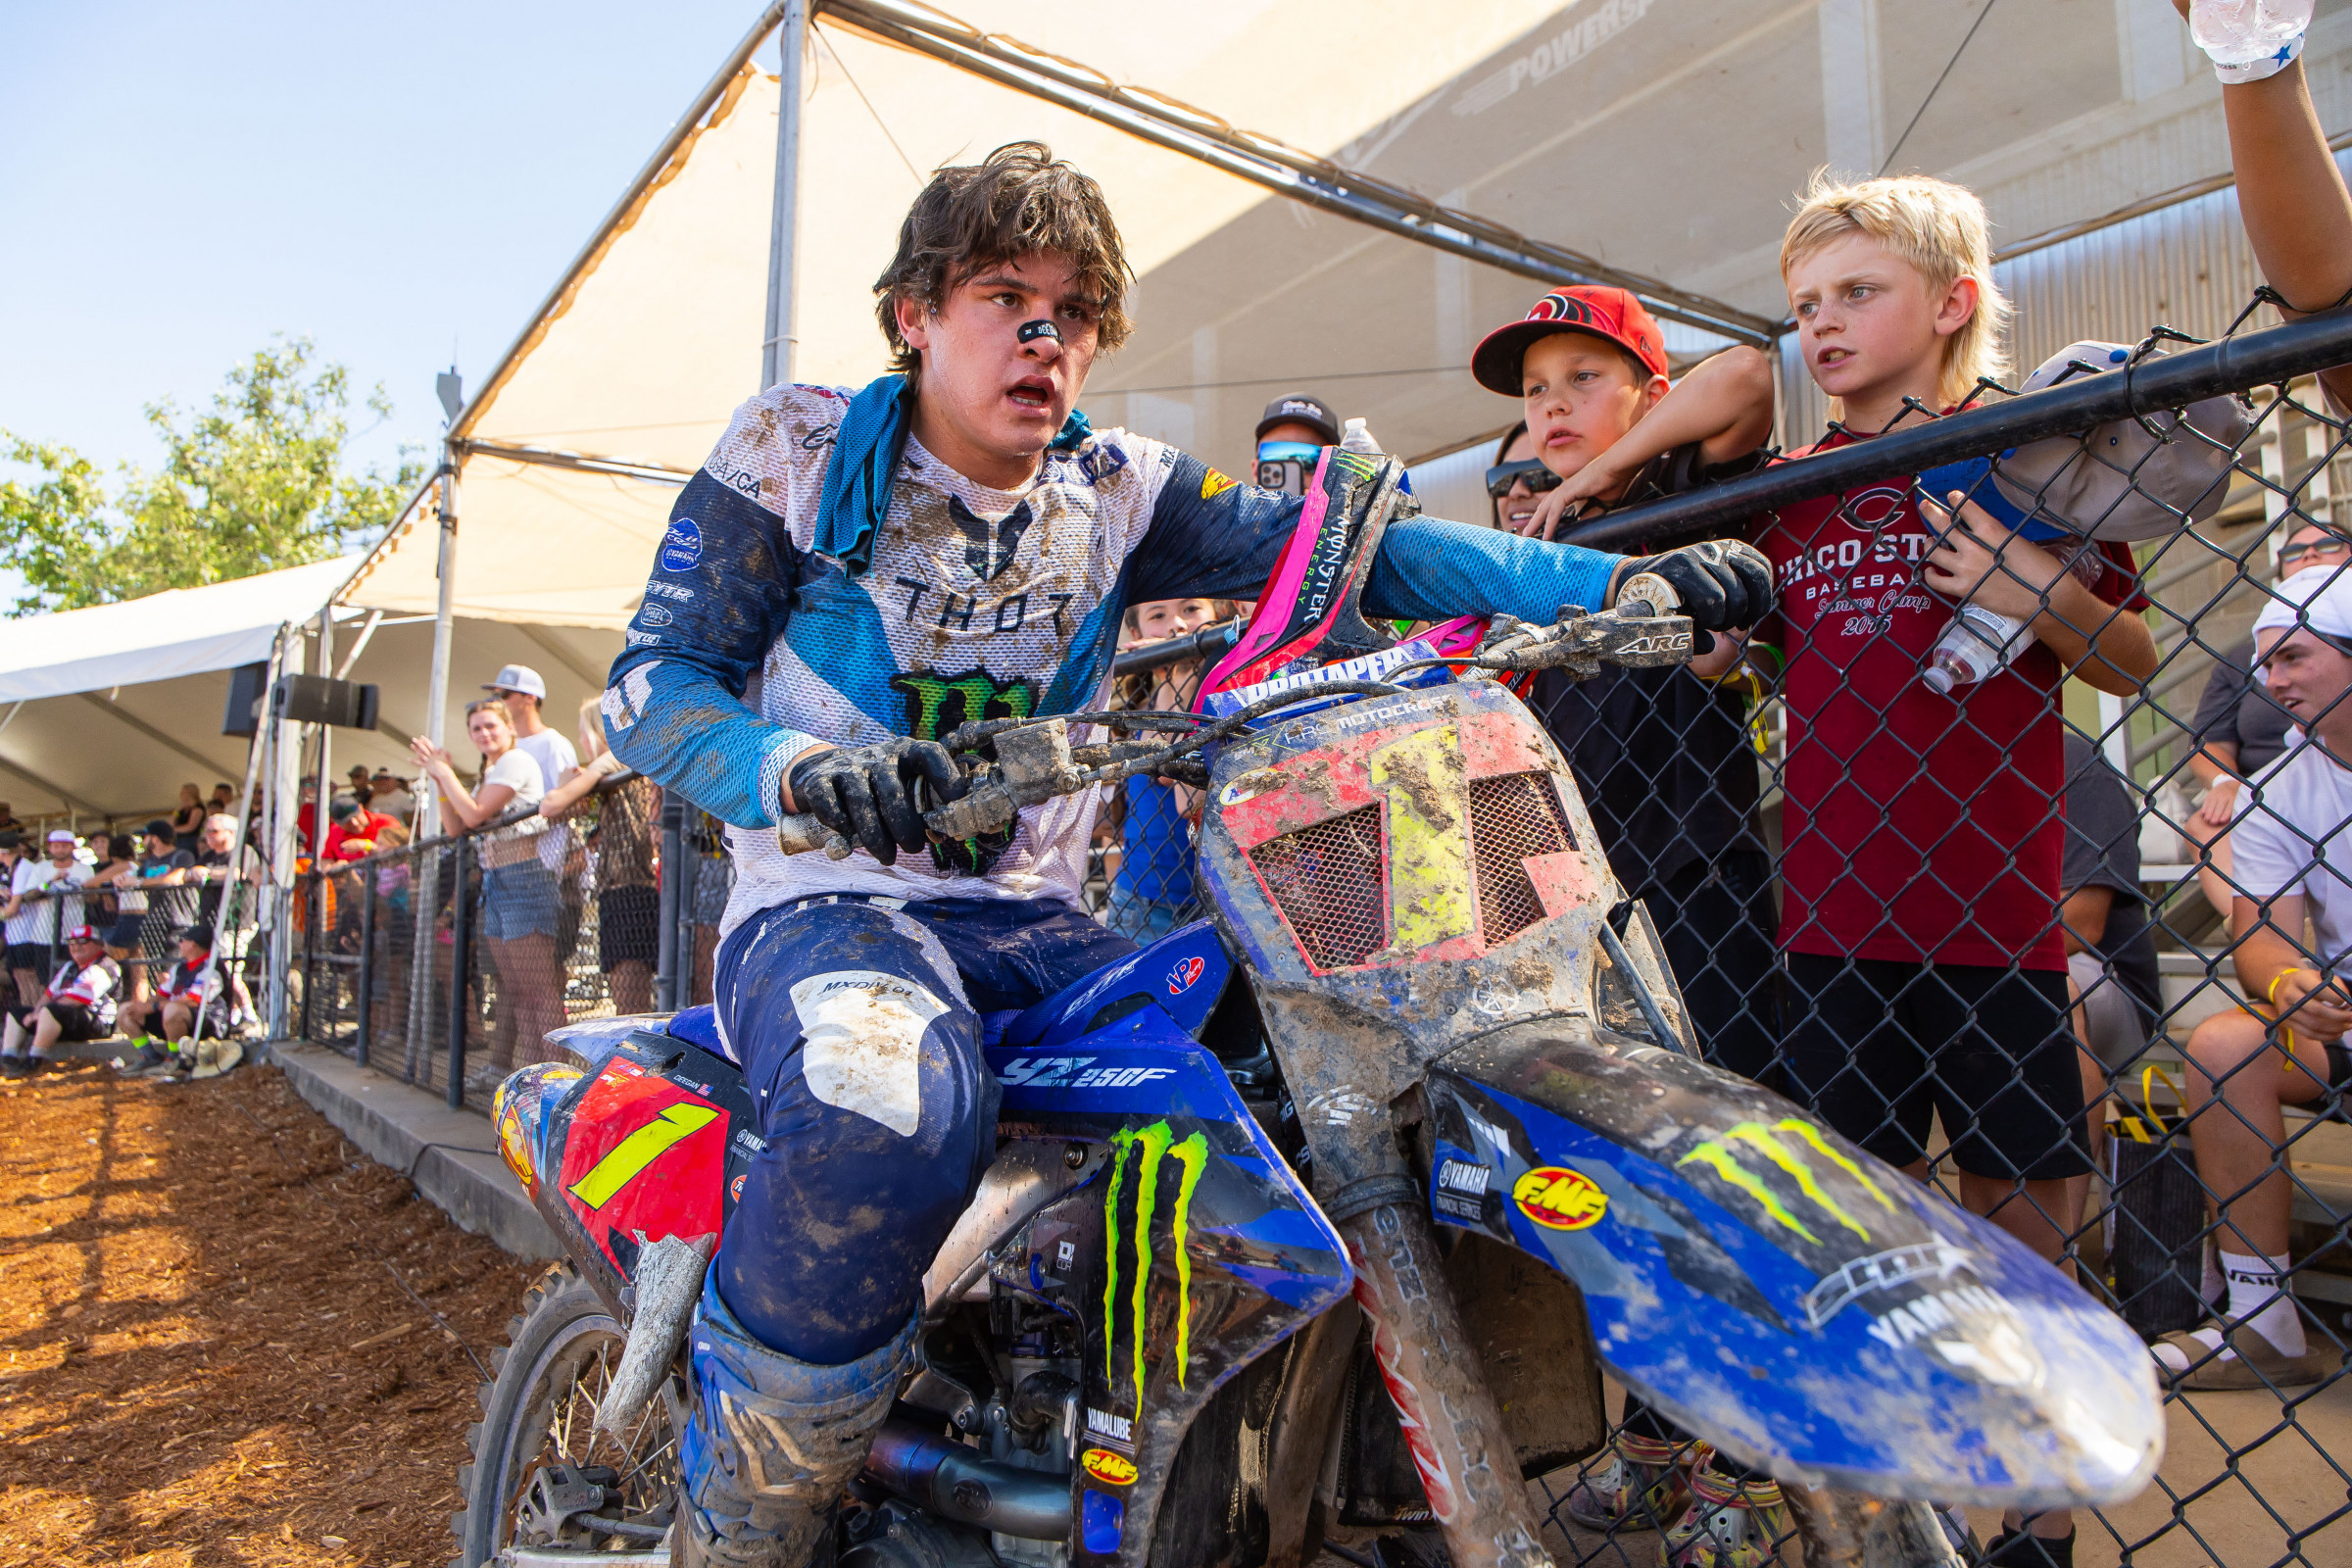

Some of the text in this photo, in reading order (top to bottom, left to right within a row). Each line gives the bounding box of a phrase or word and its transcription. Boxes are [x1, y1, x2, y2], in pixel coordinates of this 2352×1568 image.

[1874, 533, 1932, 564] ST
[1298, 527, 1328, 605] ENERGY
[1303, 515, 1350, 622] MONSTER
[1814, 588, 1932, 620] Summer Camp
[1615, 632, 1691, 656] ARC
[1166, 957, 1193, 994] VP
[672, 1074, 701, 1090] DEEGAN
[567, 1101, 721, 1212] 1
[1448, 1162, 1491, 1197] YAMAHA
[1512, 1173, 1610, 1219] FMF
[1437, 1195, 1482, 1222] FINANCIAL SERVICES
[1087, 1406, 1132, 1442] YAMALUBE
[1082, 1451, 1138, 1480] FMF
[1396, 1504, 1430, 1521] Twin
